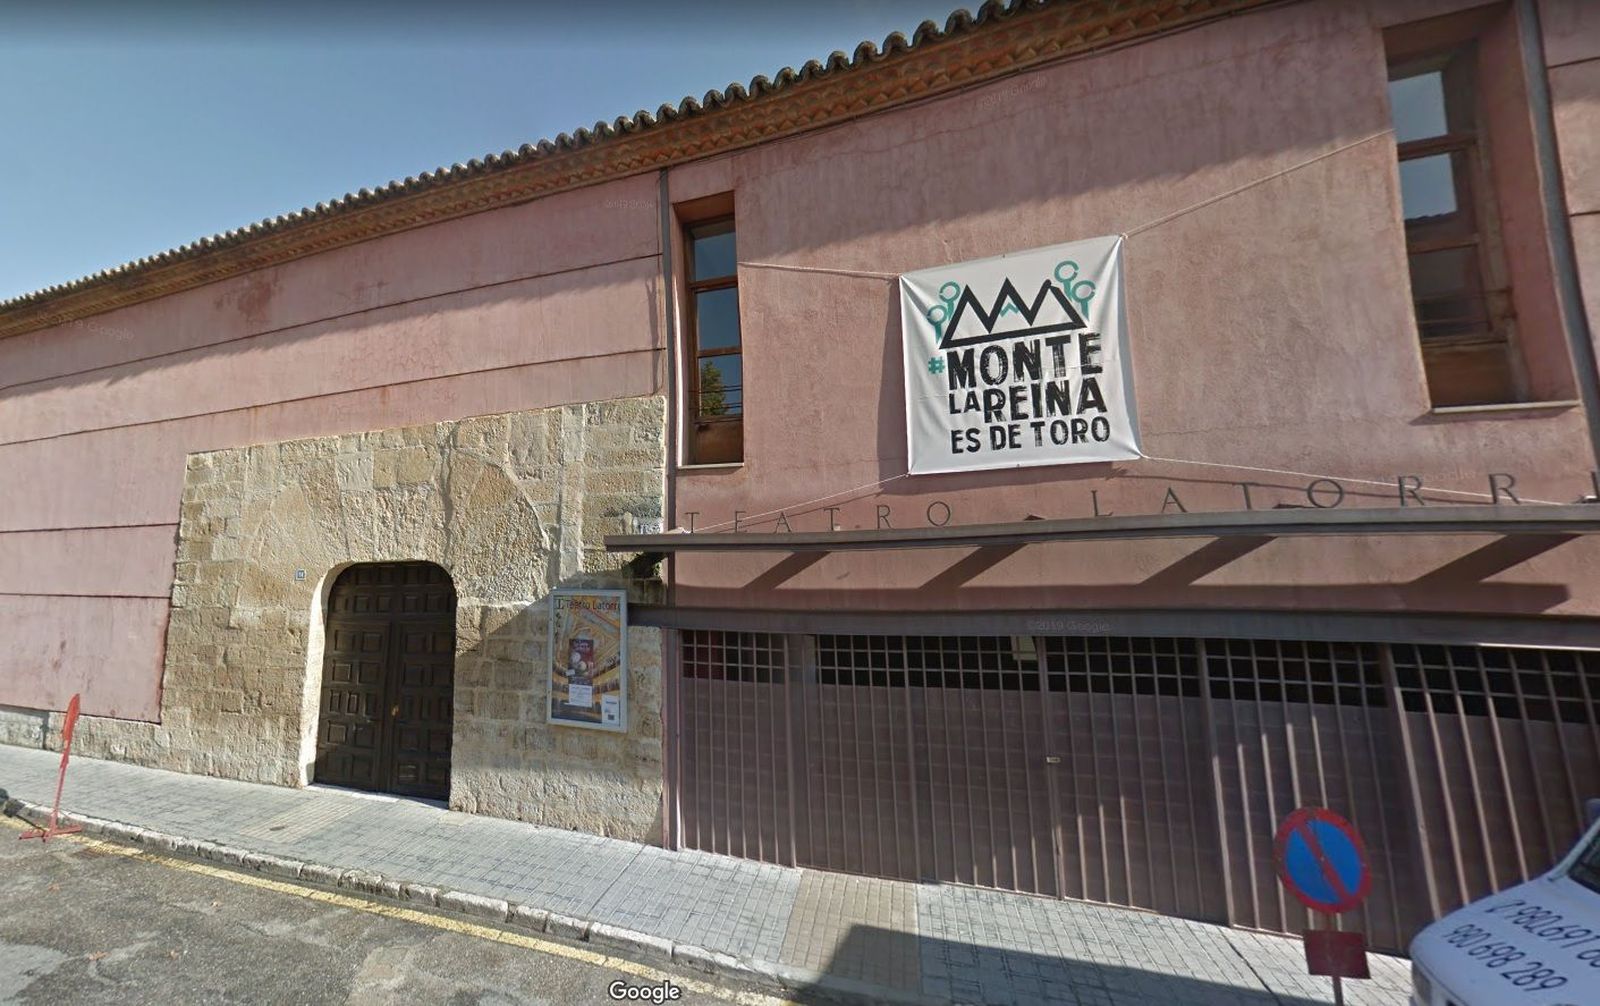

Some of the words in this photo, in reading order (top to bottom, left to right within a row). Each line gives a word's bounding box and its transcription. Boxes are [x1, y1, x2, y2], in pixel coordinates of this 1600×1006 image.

[949, 390, 981, 415] LA
[983, 376, 1108, 424] REINA
[951, 428, 981, 455] ES
[990, 424, 1022, 451] DE
[1030, 416, 1111, 448] TORO
[685, 501, 951, 534] TEATRO
[566, 599, 591, 610] Teatro
[1467, 942, 1526, 969] 698
[1499, 961, 1567, 992] 289
